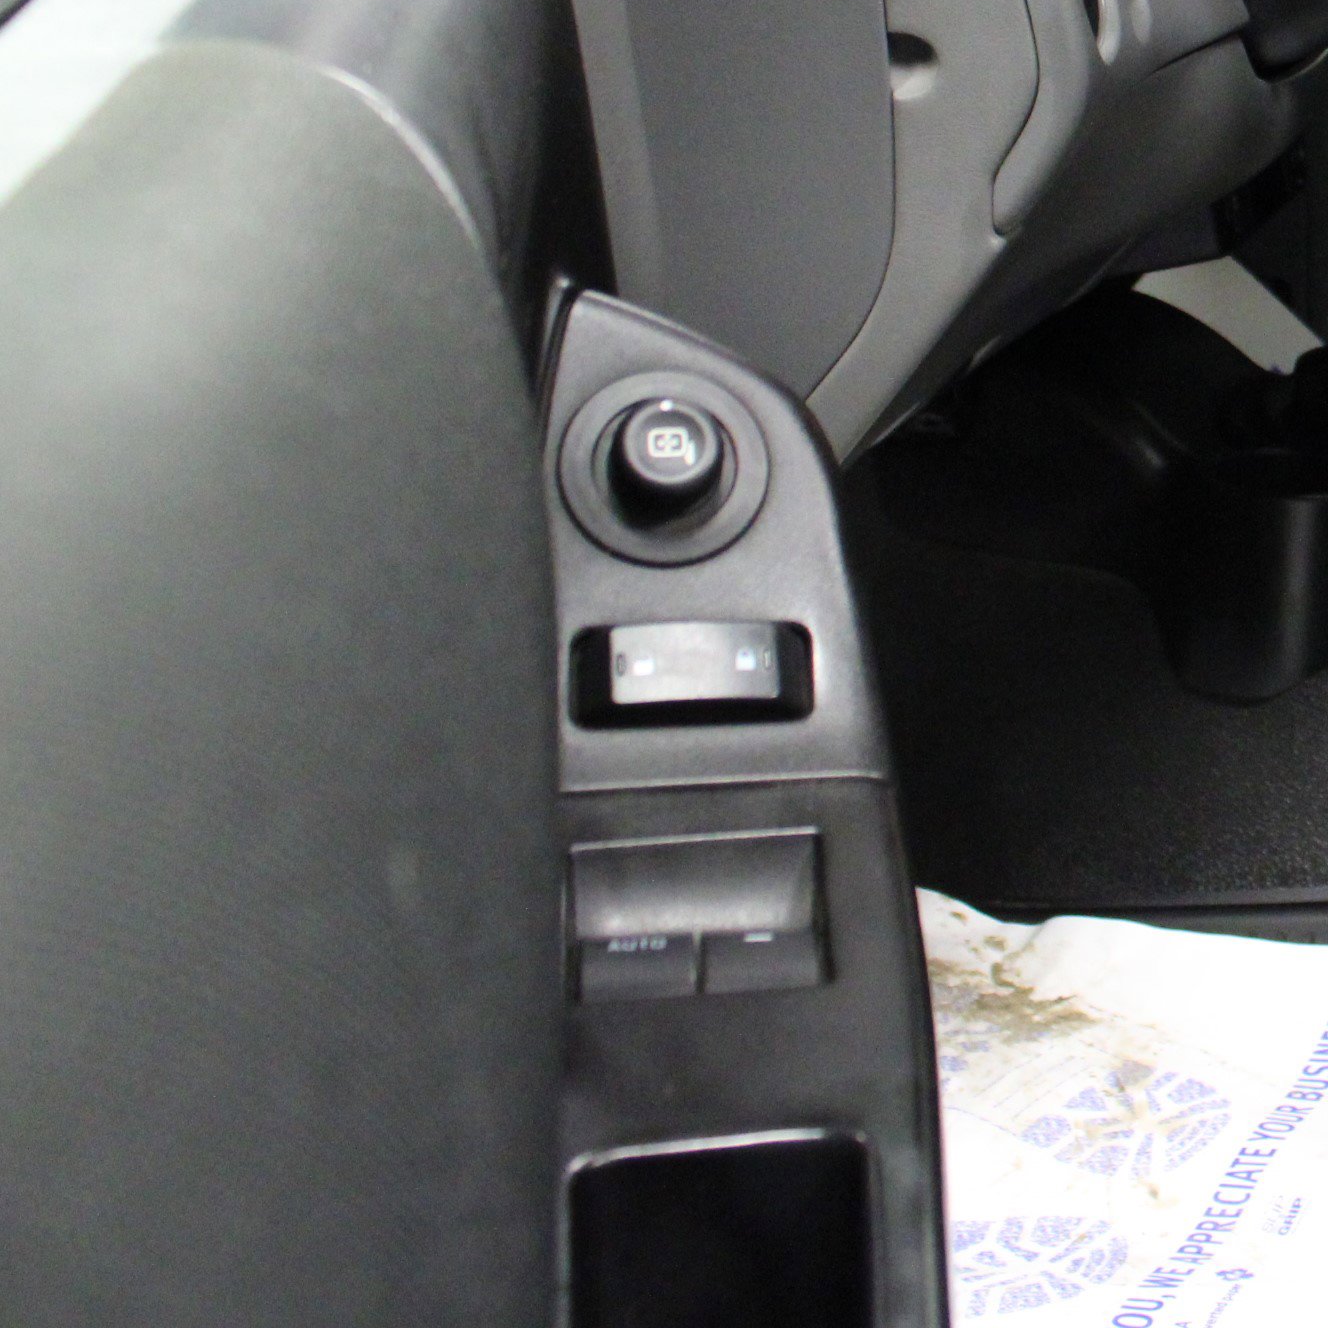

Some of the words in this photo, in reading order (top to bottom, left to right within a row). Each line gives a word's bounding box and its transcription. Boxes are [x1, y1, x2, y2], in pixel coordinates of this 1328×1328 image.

[1137, 1266, 1195, 1289] WE
[1168, 1147, 1278, 1266] APPRECIATE
[1246, 1104, 1315, 1142] YOUR
[1277, 1197, 1302, 1236] GRIP
